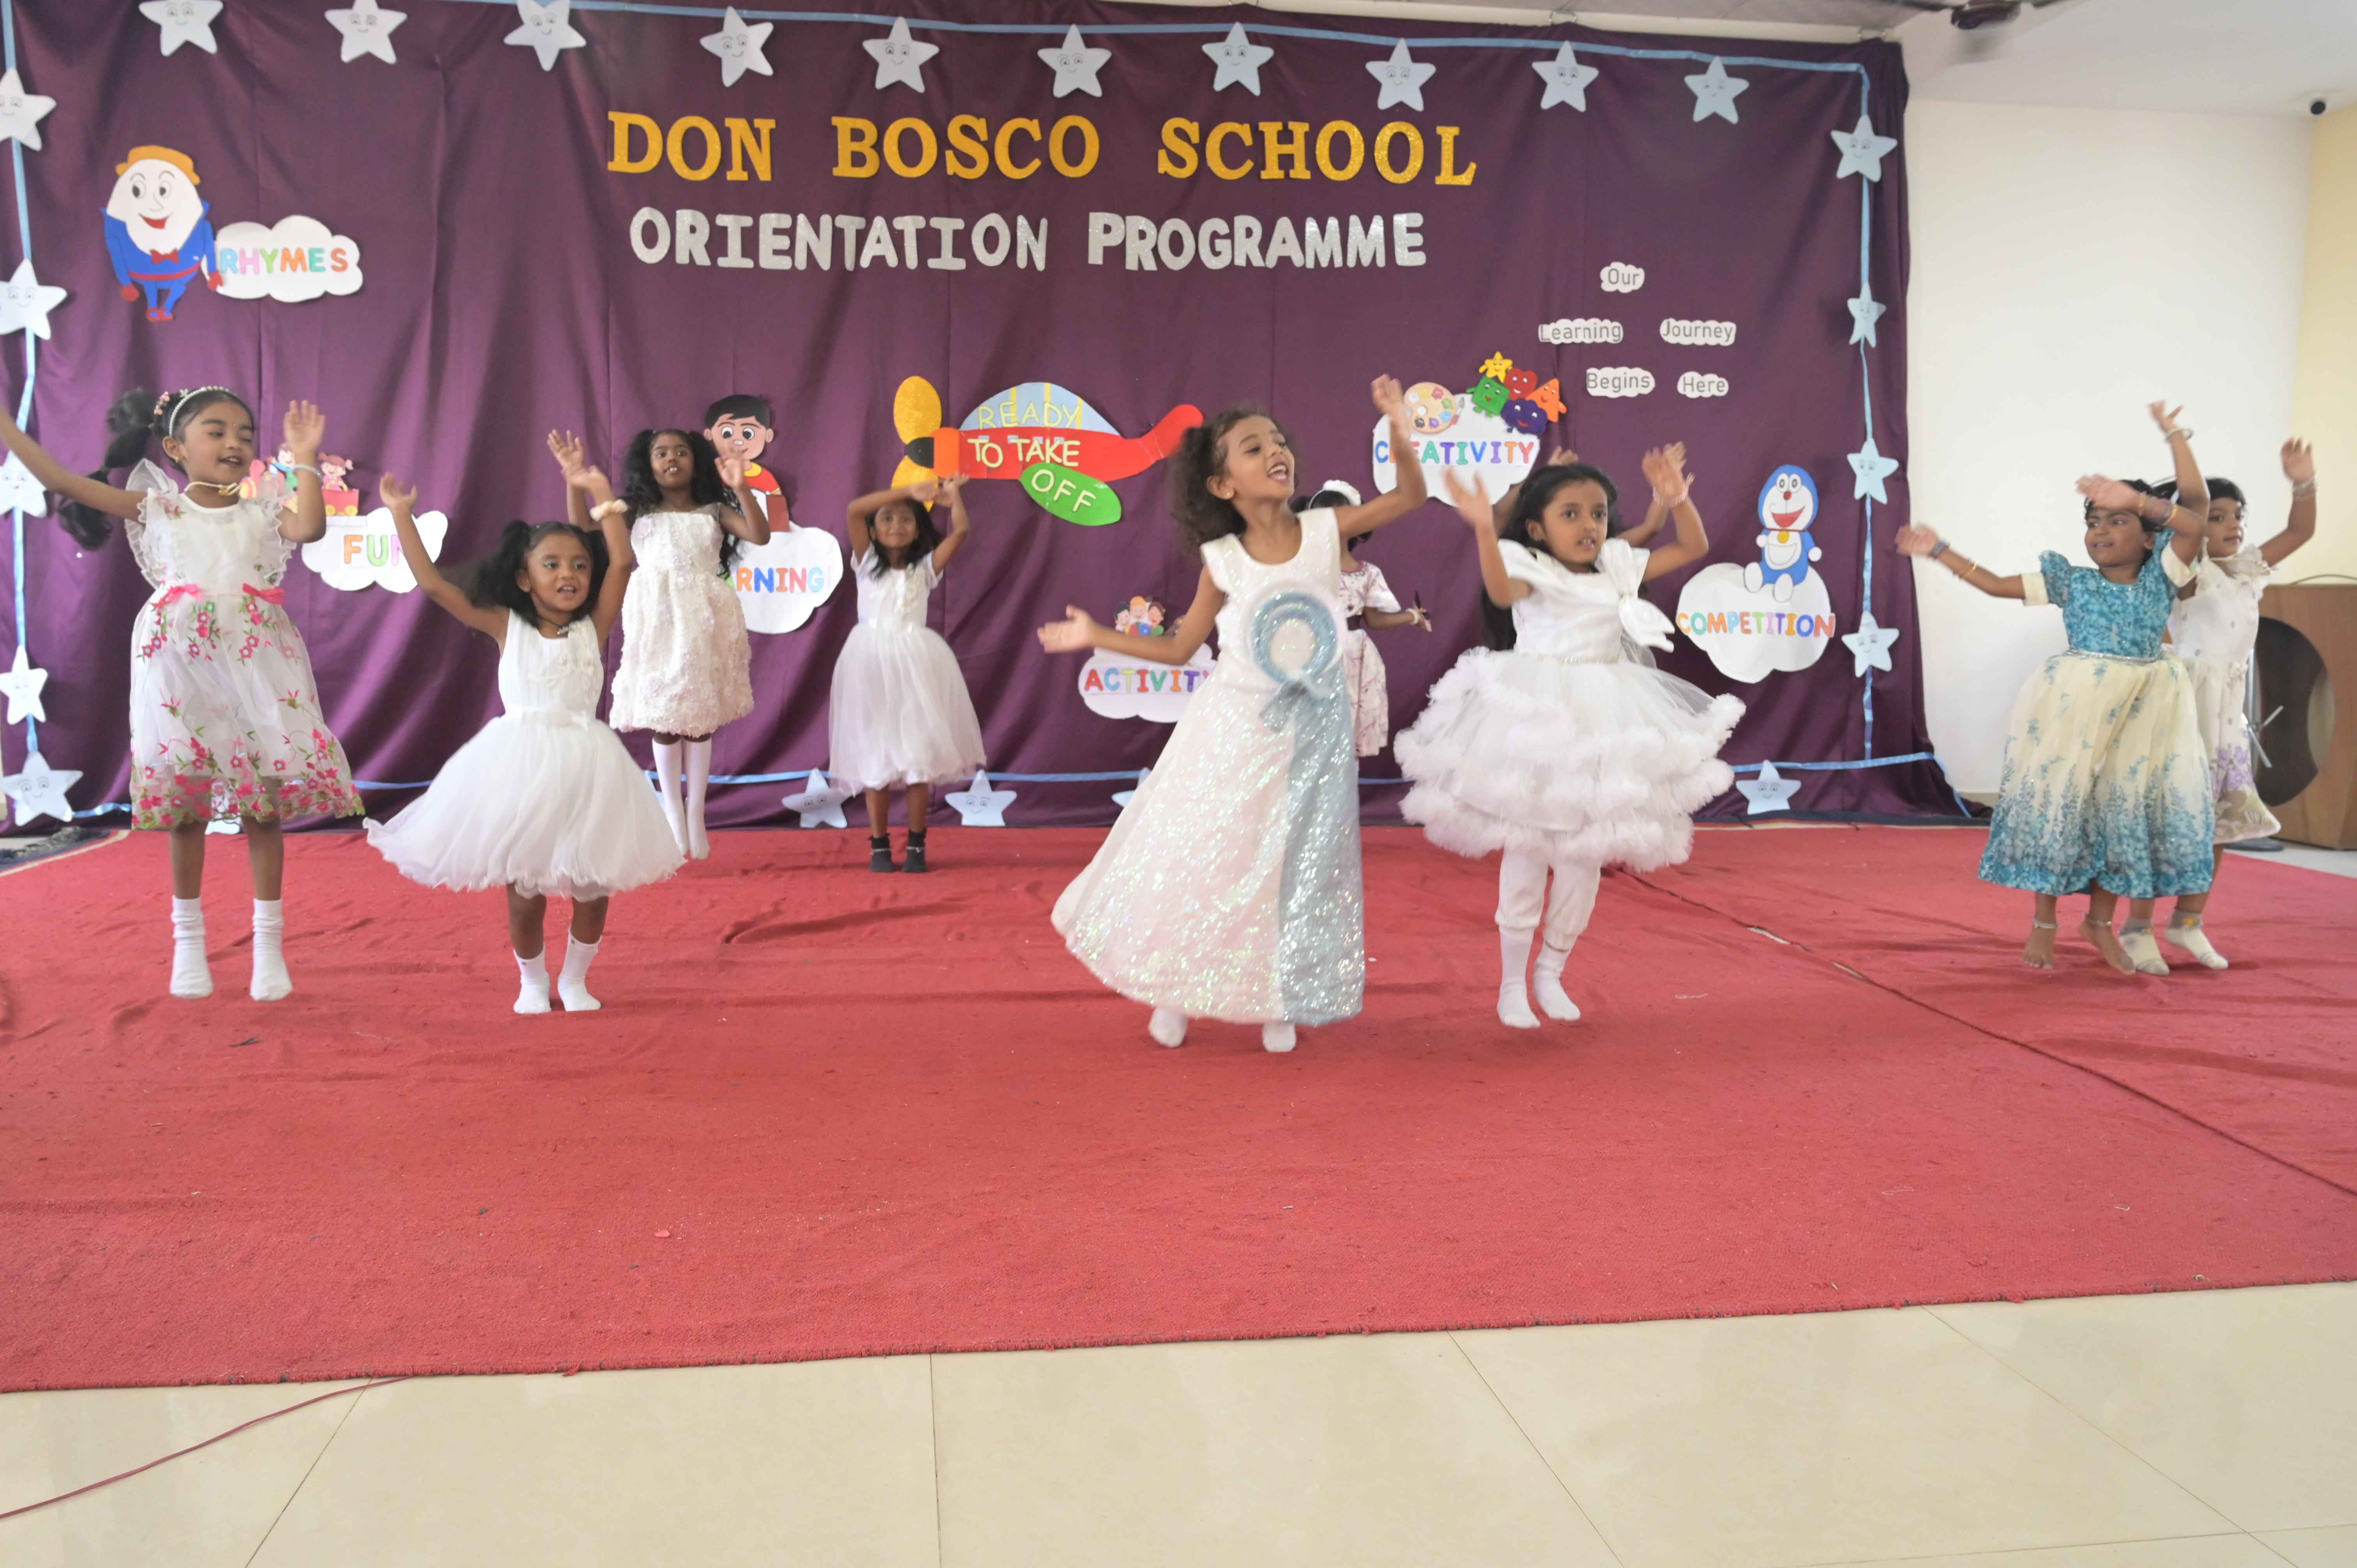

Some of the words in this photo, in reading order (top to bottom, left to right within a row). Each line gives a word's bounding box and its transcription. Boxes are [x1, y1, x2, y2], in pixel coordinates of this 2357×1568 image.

[607, 111, 776, 182] DON
[831, 113, 1101, 180] BOSCO
[1157, 117, 1477, 186] SCHOOL
[629, 206, 1048, 272] ORIENTATION
[1088, 211, 1427, 272] PROGRAMME
[220, 247, 348, 274] RHYMES
[1608, 268, 1640, 285] Our
[1540, 322, 1621, 342] Learning
[1663, 320, 1733, 342] Journey
[1586, 373, 1650, 392] Begins
[1683, 377, 1726, 392] Here
[978, 401, 1083, 429] READY
[968, 438, 1004, 468] TO
[1012, 438, 1081, 467] TAKE
[1375, 440, 1534, 465] CATIVITY
[1031, 468, 1097, 513] OFF
[721, 567, 824, 593] RNING
[1677, 611, 1835, 638] COMPETITION
[1084, 667, 1209, 692] ACTIVIT
